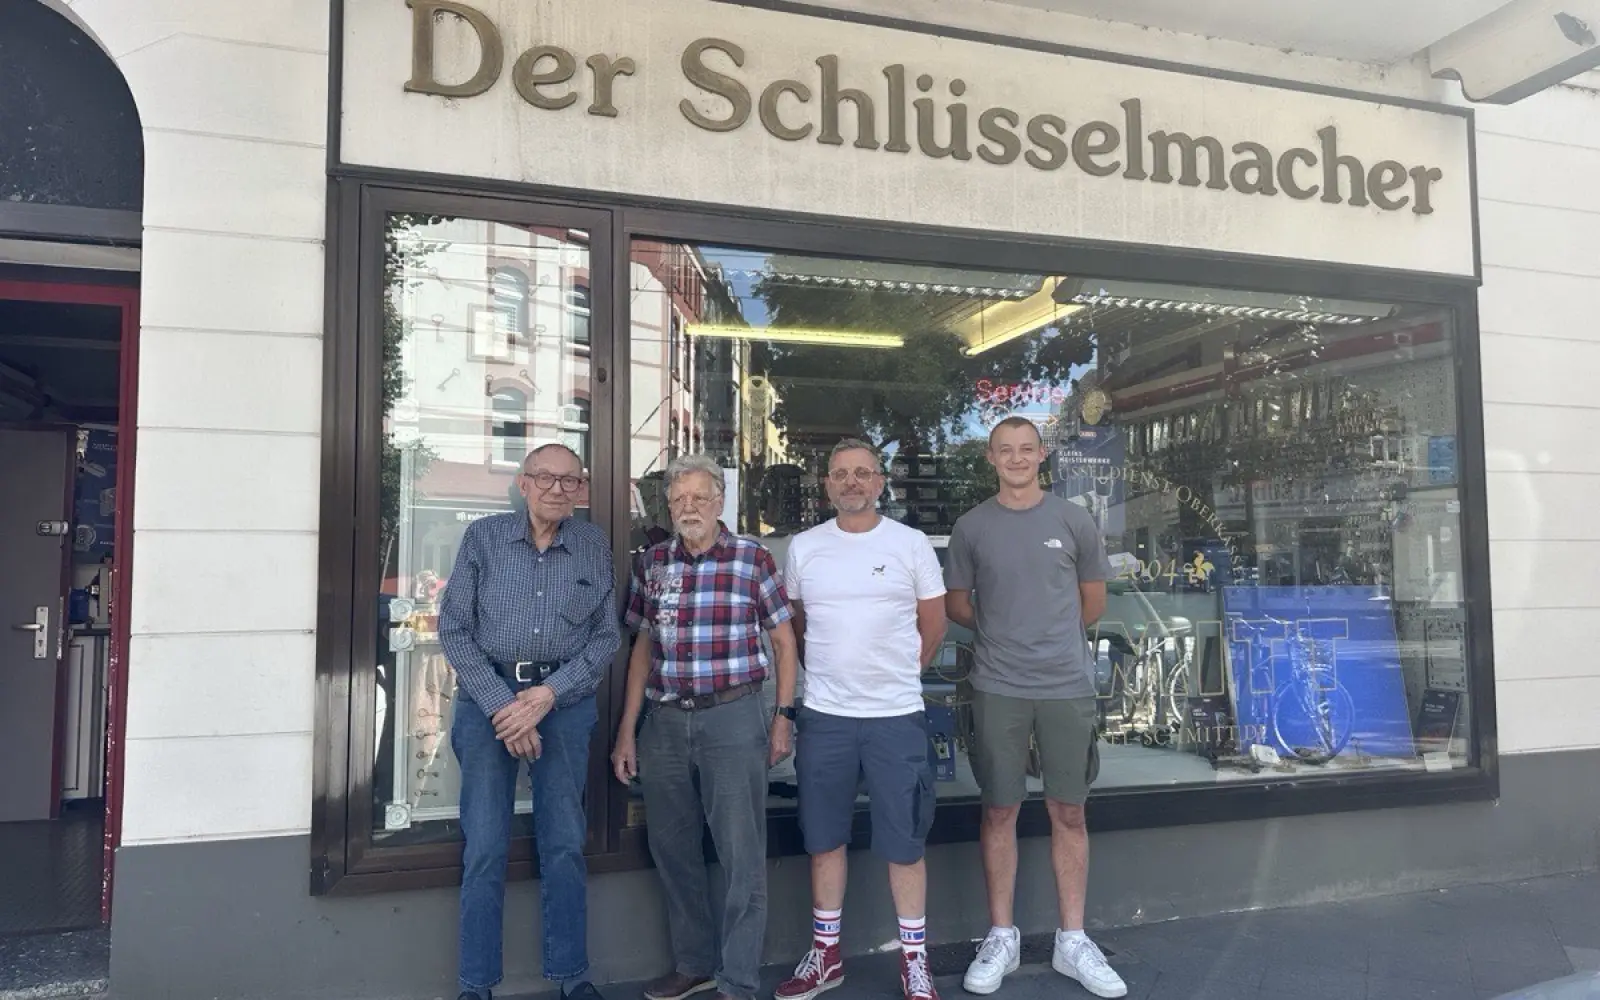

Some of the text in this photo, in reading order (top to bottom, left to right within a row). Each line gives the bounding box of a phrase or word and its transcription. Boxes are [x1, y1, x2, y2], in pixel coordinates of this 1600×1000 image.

[403, 0, 1442, 214] Der Schlüsselmacher
[976, 379, 1065, 405] Service
[1095, 618, 1349, 698] MITT
